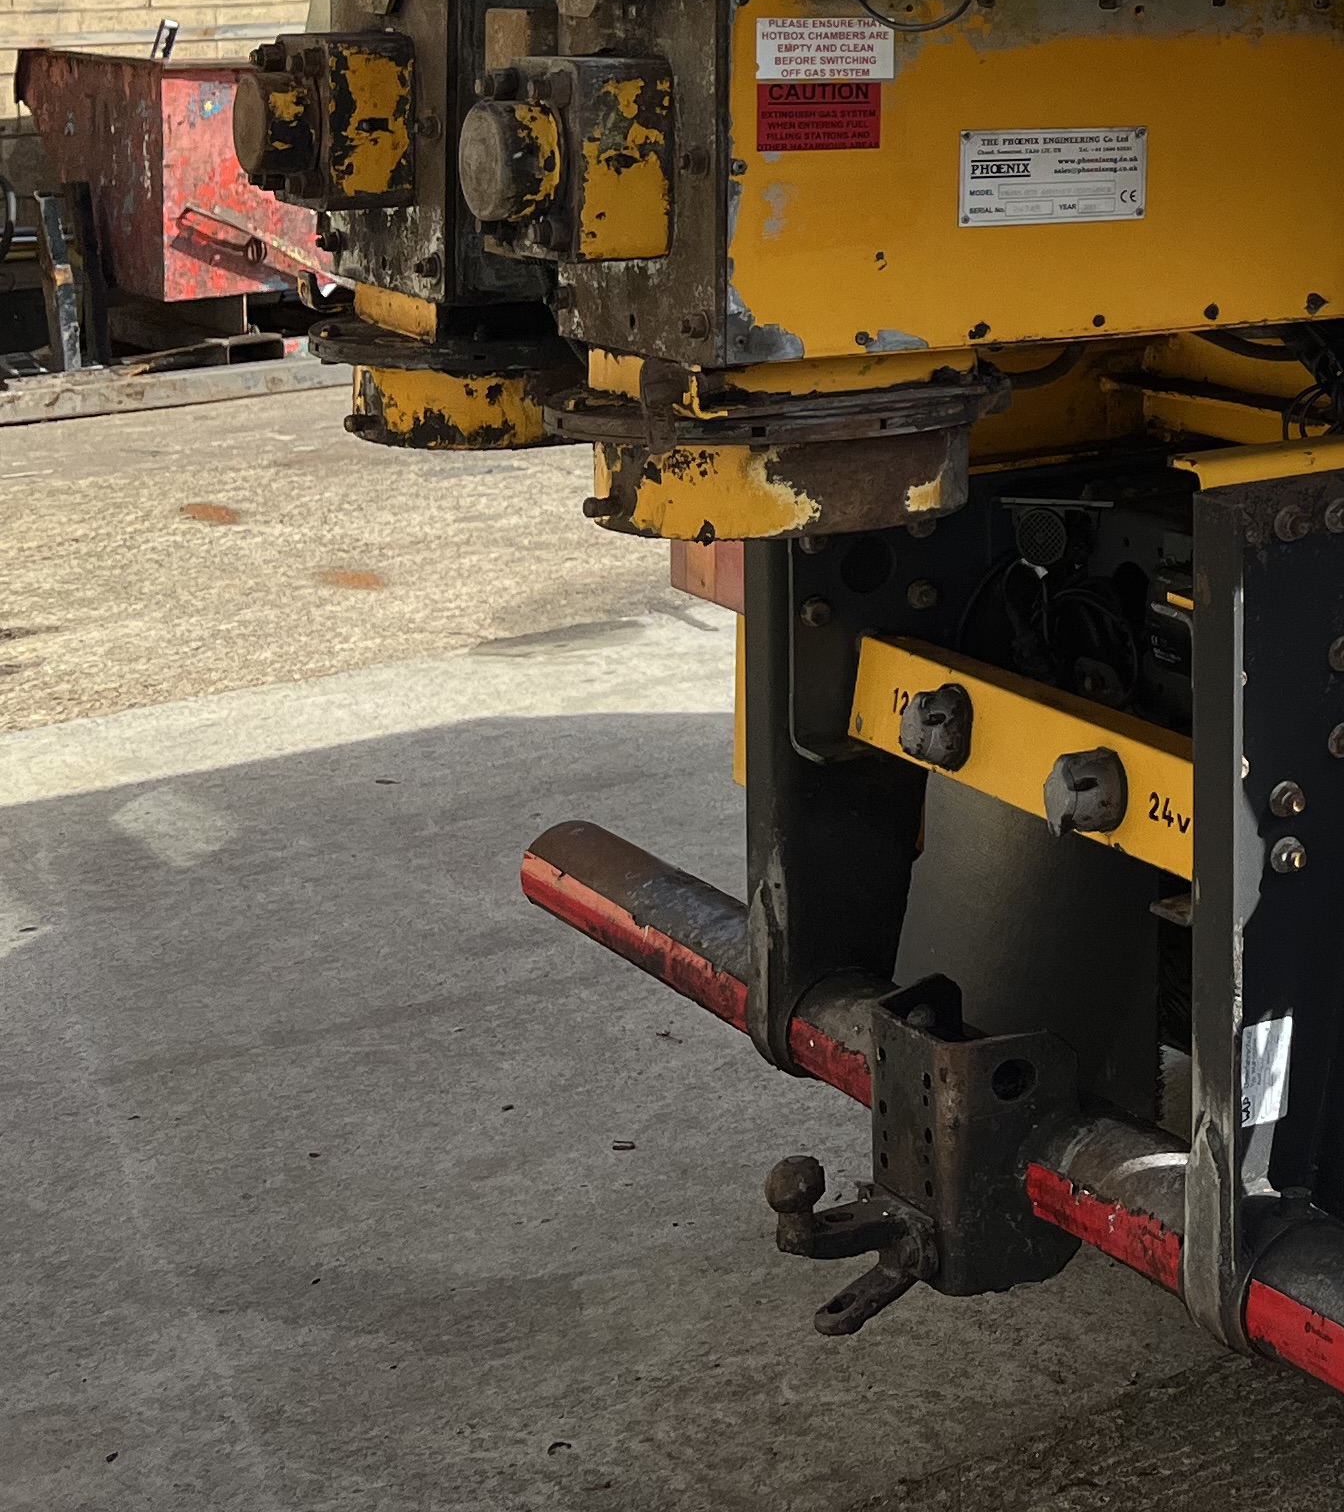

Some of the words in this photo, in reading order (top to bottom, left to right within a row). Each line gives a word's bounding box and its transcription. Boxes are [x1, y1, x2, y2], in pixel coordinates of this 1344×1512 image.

[768, 19, 809, 28] PLEASE
[812, 19, 854, 28] ENSURE
[762, 32, 805, 40] HOTBOX
[808, 32, 866, 40] CHAMBERS
[868, 31, 889, 40] ARE
[778, 44, 812, 53] EMPTY
[815, 44, 837, 53] AND
[840, 44, 874, 52] CLEAN
[774, 56, 817, 66] BEFORE
[820, 56, 876, 65] SWITCHING
[781, 68, 801, 78] OFF
[804, 68, 826, 77] GAS
[829, 68, 870, 76] SYSTEM
[768, 84, 870, 100] CAUTION
[761, 110, 816, 120] EXTINGUISH
[819, 110, 838, 118] GAS
[840, 109, 876, 118] SYSTEM
[768, 122, 796, 130] WHEN
[798, 120, 844, 129] ENTERING
[846, 120, 869, 128] FUEL
[766, 132, 801, 141] FILLING
[802, 132, 848, 140] STATIONS
[851, 132, 870, 140] AND
[981, 138, 1000, 146] THE
[1043, 136, 1100, 144] ENGINEERING
[850, 142, 880, 150] AREAS
[969, 206, 993, 214] SERIAL
